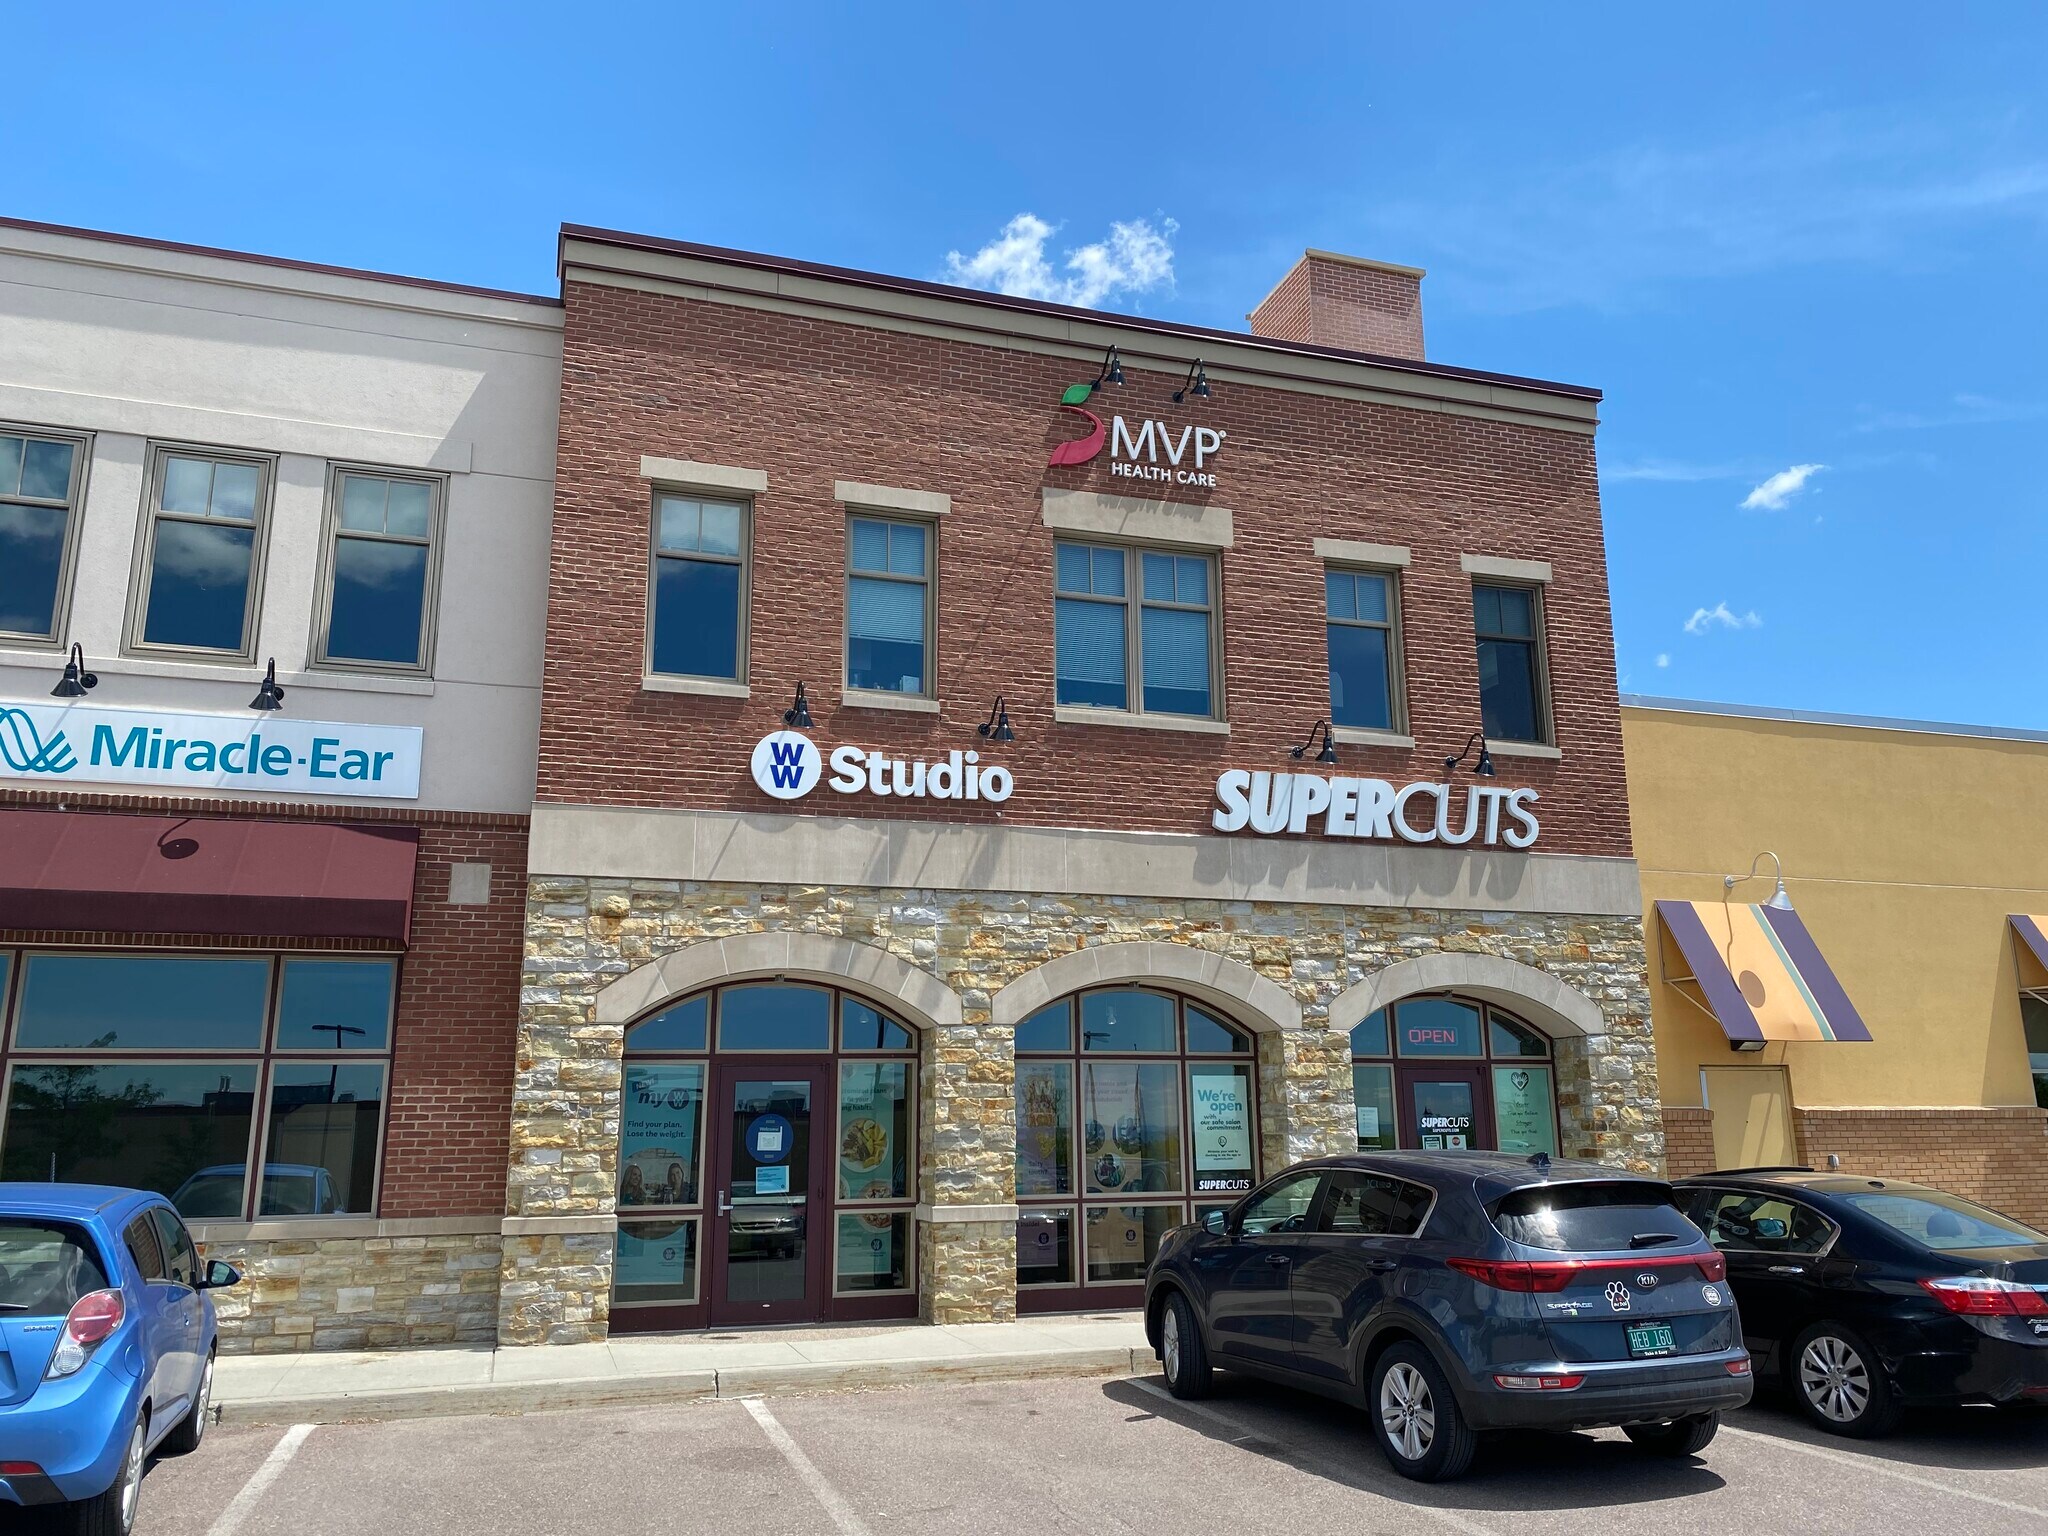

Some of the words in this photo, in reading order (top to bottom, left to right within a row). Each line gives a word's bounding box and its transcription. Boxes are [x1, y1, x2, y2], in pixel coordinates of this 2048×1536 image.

[1111, 415, 1222, 469] MVP
[1111, 462, 1172, 482] HEALTH
[1176, 470, 1217, 488] CARE
[90, 724, 393, 781] Miracle-Ear
[828, 746, 1014, 802] Studio
[1212, 769, 1540, 849] SUPERCUTS
[1408, 1029, 1456, 1043] OPEN
[1198, 1089, 1236, 1102] We're
[1210, 1102, 1243, 1115] open
[663, 1121, 682, 1129] plan.
[1421, 1117, 1470, 1128] SUPERCUTS
[1199, 1179, 1250, 1190] SUPERCUTS
[1641, 1276, 1655, 1285] KIA
[1630, 1331, 1650, 1349] HEB
[1653, 1329, 1673, 1346] 160
